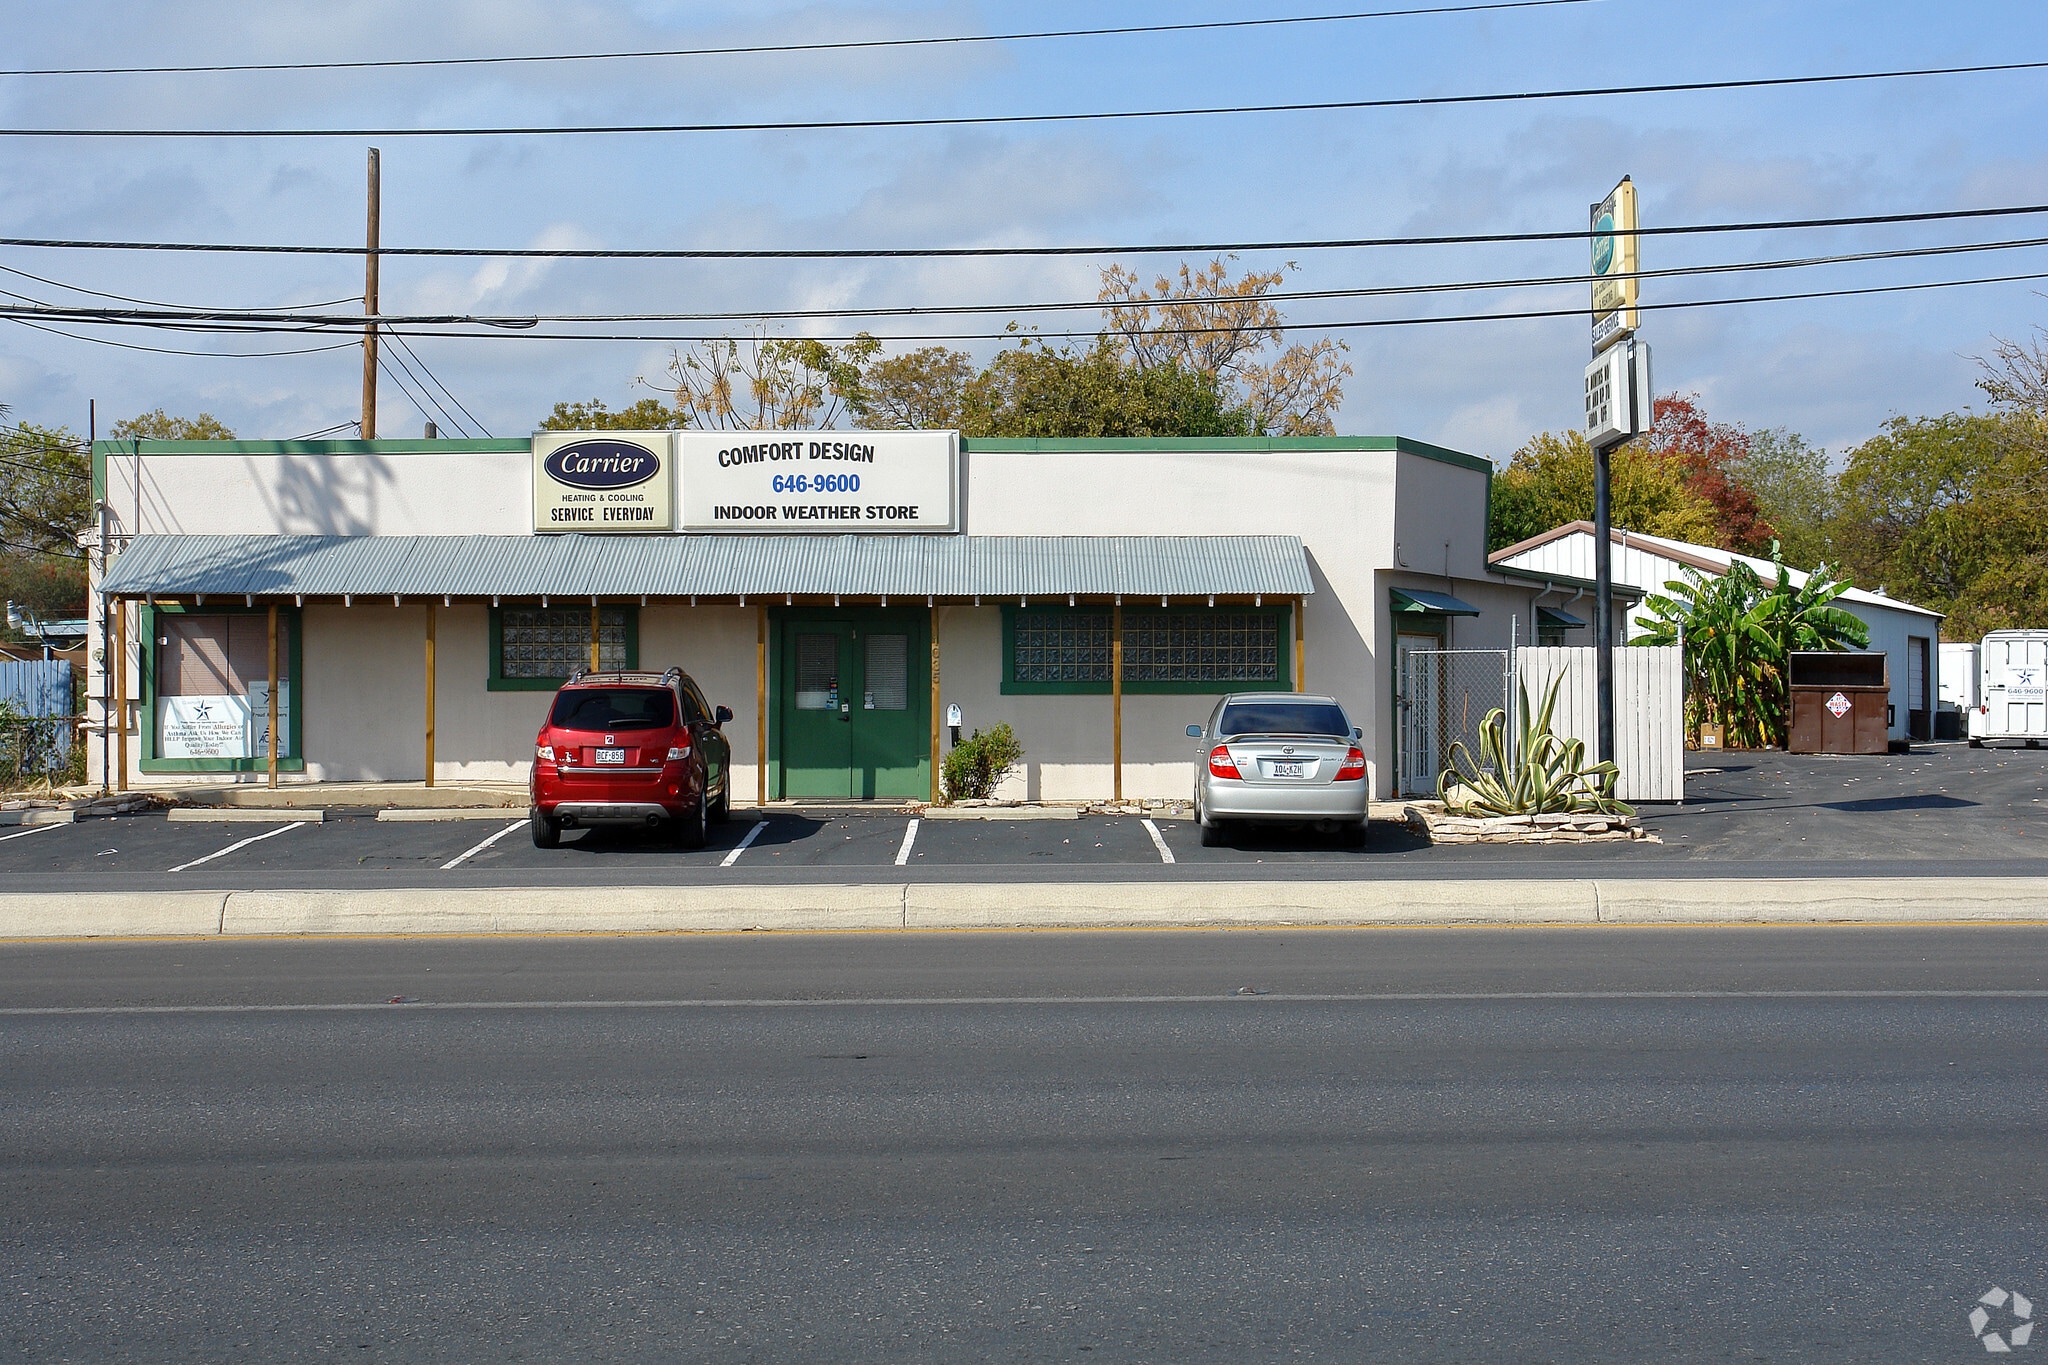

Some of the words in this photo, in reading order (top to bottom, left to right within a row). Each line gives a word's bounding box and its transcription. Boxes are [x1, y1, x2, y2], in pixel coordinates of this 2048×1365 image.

[561, 452, 644, 473] Carrier
[718, 442, 804, 468] COMFORT
[809, 442, 875, 463] DESIGN
[772, 474, 861, 493] 646-9600
[562, 494, 596, 502] HEATING
[599, 494, 605, 502] &
[607, 494, 644, 502] COOLING
[551, 507, 594, 521] SERVICE
[603, 507, 654, 521] EVERYDAY
[714, 505, 777, 520] INDOOR
[782, 505, 861, 520] WEATHER
[865, 505, 919, 519] STORE
